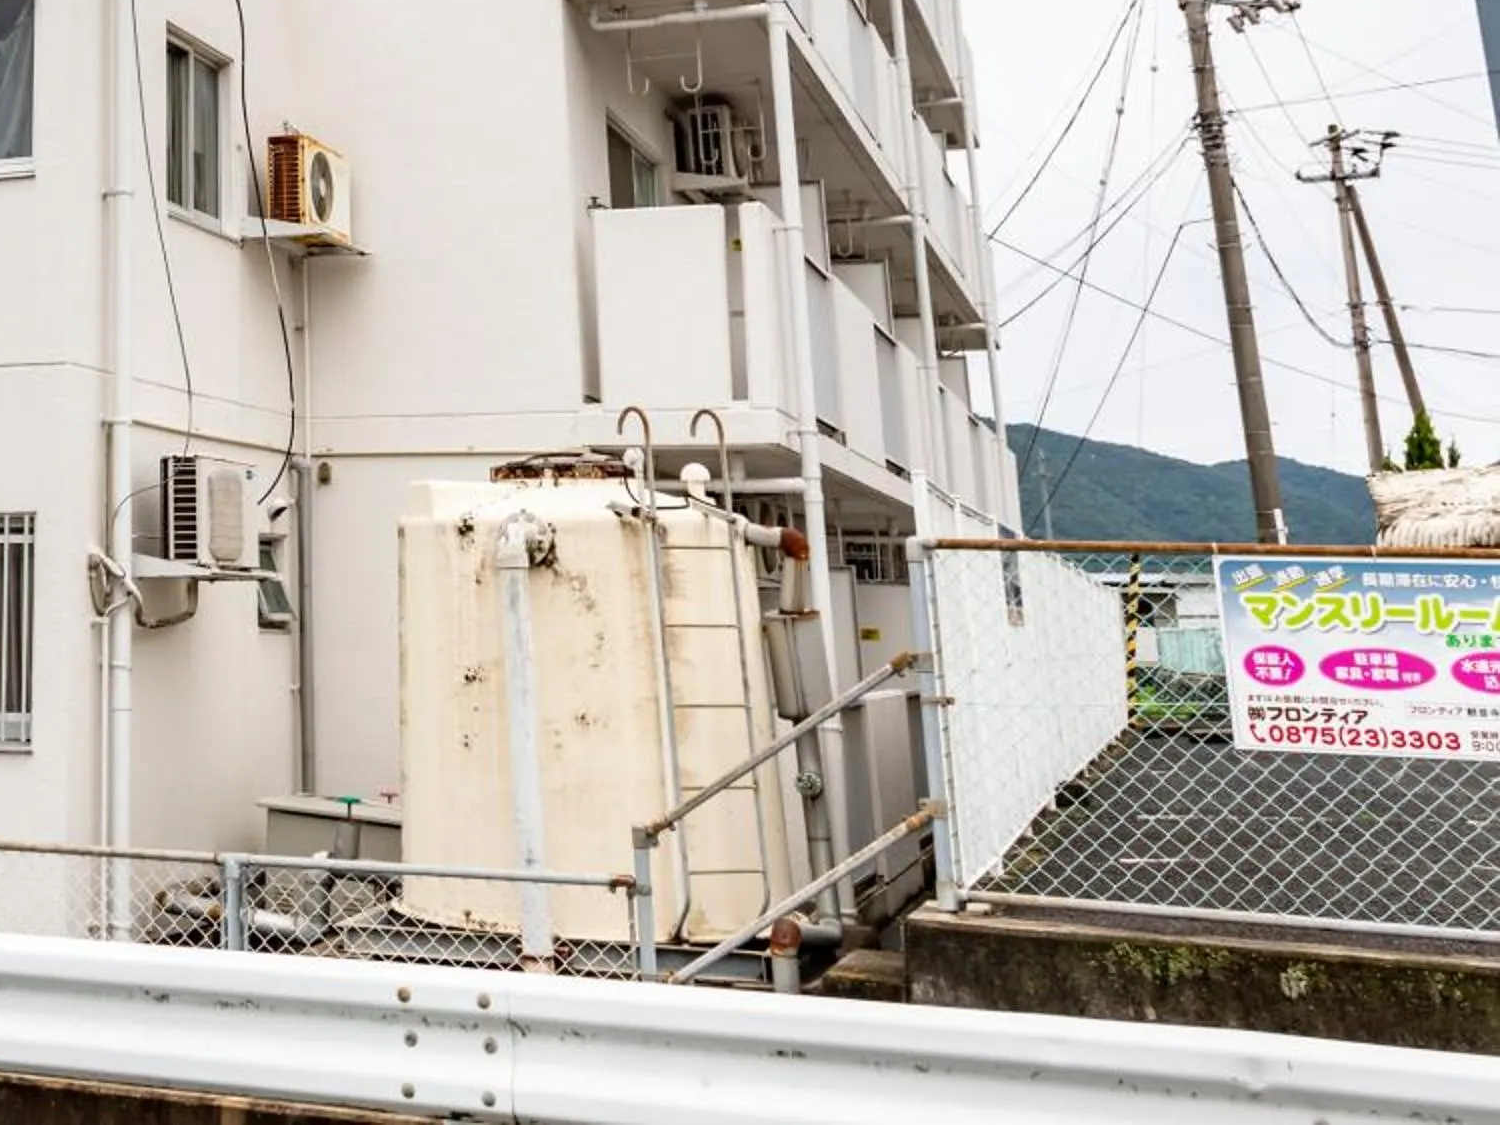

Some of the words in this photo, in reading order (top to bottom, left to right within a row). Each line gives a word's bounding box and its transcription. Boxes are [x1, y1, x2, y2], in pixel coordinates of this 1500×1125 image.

[1241, 593, 1500, 632] マンスリールー
[1269, 724, 1461, 752] 0875(23)3303
